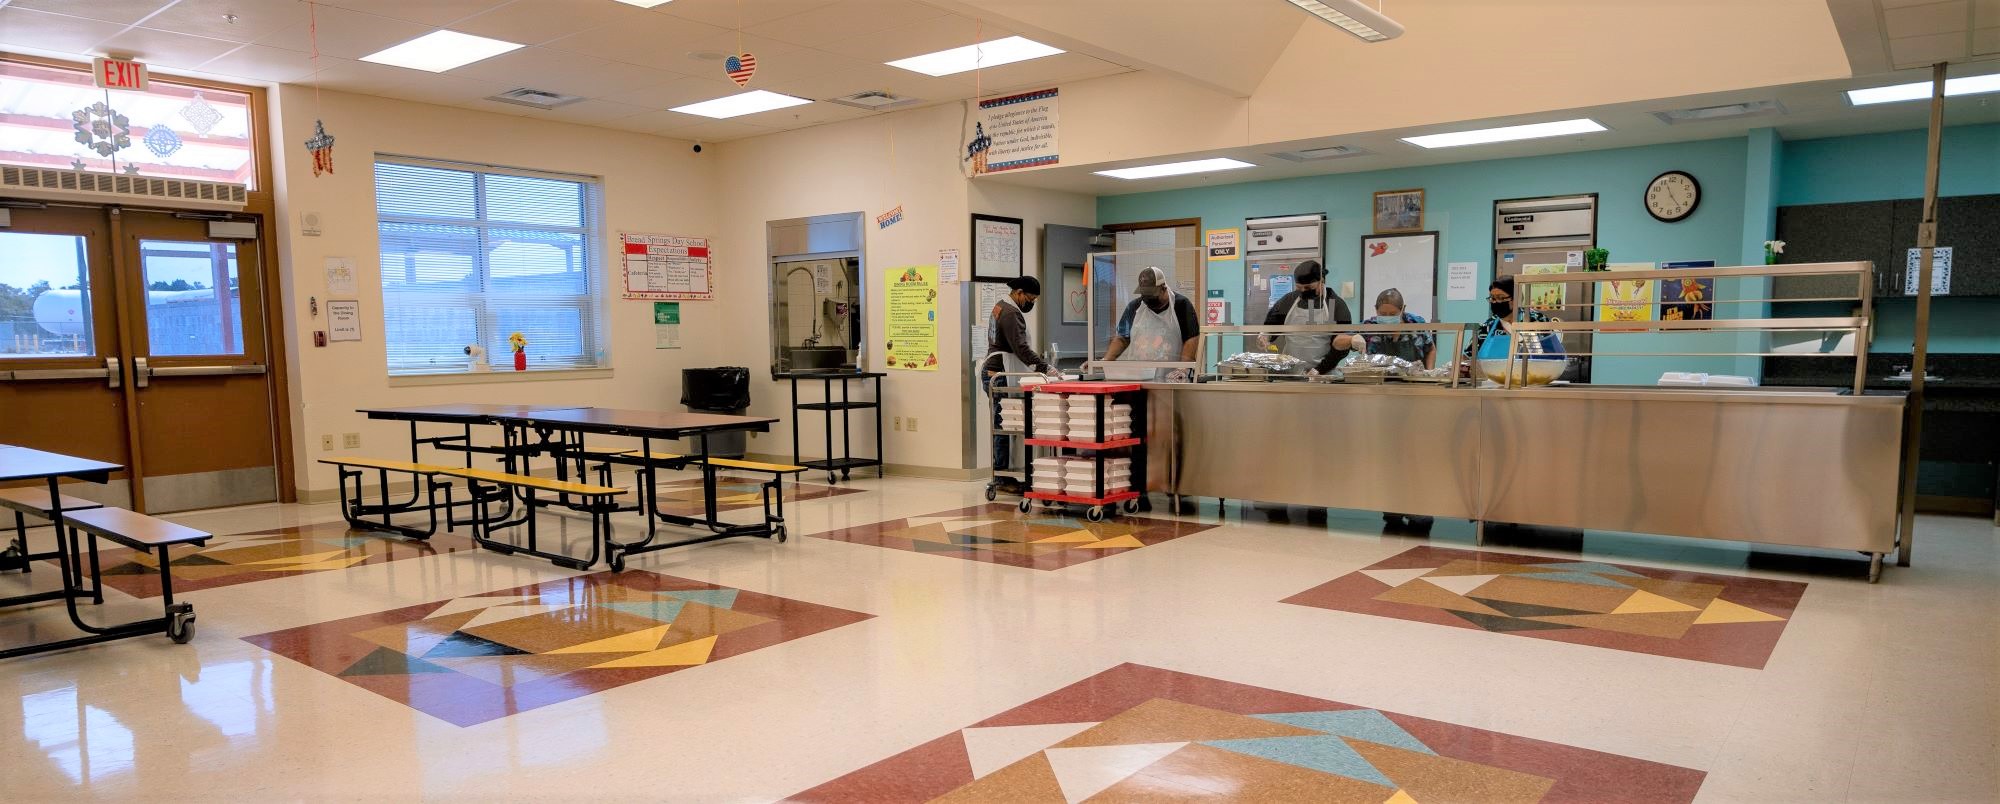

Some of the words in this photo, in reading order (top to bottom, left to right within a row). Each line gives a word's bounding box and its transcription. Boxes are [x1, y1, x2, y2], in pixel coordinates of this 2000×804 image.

[104, 60, 140, 88] EXIT
[1038, 105, 1049, 113] Flag
[880, 213, 903, 229] HOME!
[648, 236, 671, 246] Springs
[673, 237, 684, 246] Day
[686, 239, 706, 247] School
[648, 246, 688, 256] Expectations
